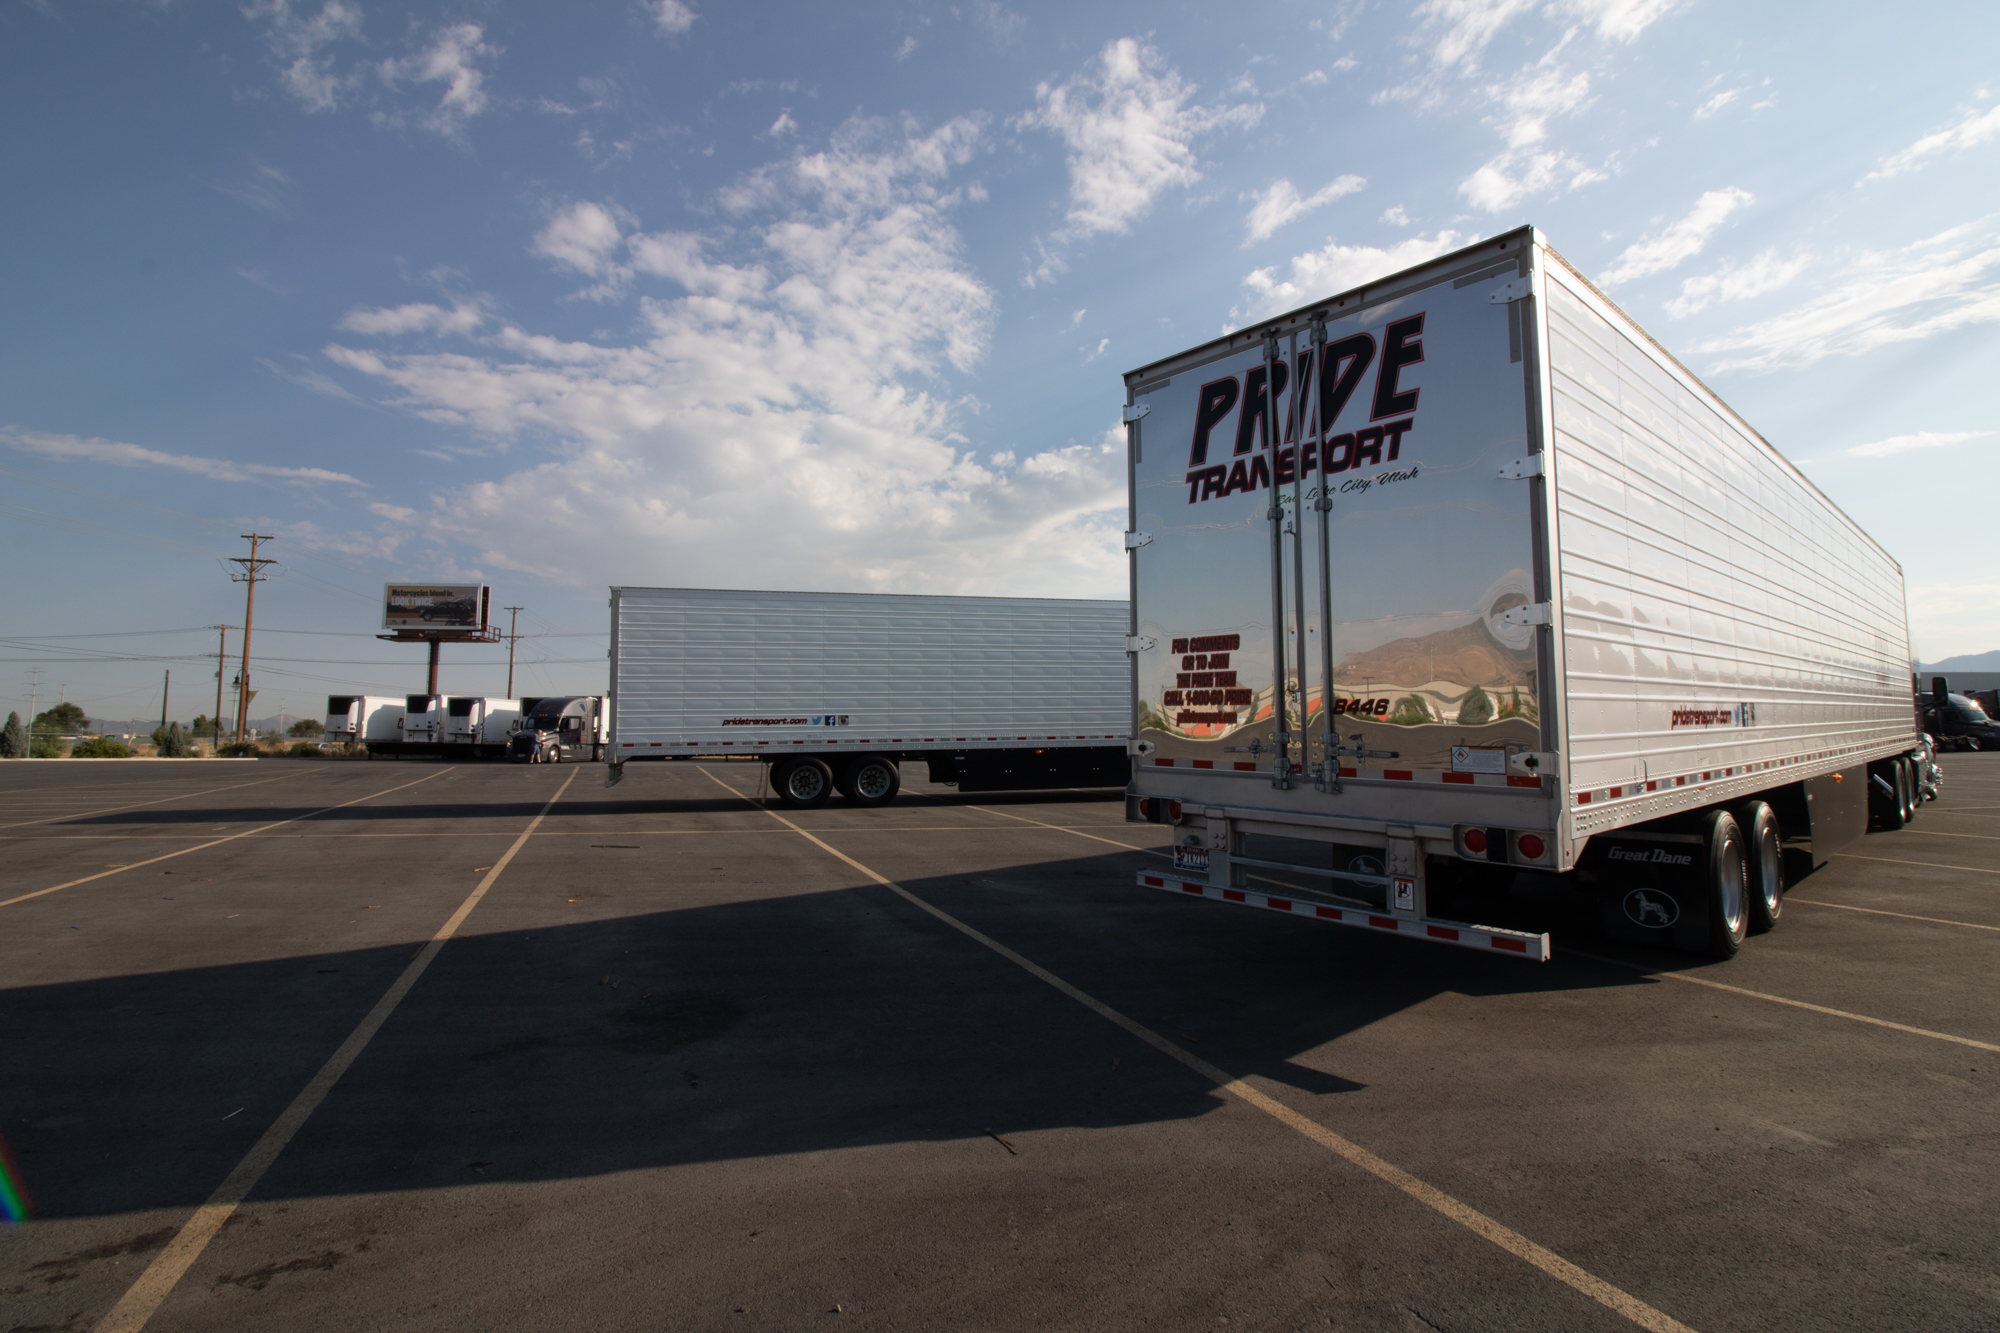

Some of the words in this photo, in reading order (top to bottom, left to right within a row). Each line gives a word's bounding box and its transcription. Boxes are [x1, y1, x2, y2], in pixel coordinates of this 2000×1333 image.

[1189, 311, 1426, 468] PRIDE
[1185, 417, 1414, 504] TRANSPORT
[1340, 479, 1372, 494] City,
[1376, 466, 1419, 485] Utah
[391, 597, 410, 606] LOOK
[392, 589, 429, 598] Motorcycles
[430, 589, 446, 597] blend
[1171, 637, 1189, 655] FOR
[1189, 633, 1240, 653] COMMENTS
[1182, 655, 1195, 671] OR
[1195, 654, 1208, 670] TO
[1208, 652, 1230, 670] JOIN
[1176, 672, 1191, 689] THE
[1191, 671, 1214, 688] PRIDE
[1214, 670, 1237, 687] TEAM
[1163, 690, 1184, 706] CALL
[1185, 689, 1224, 706] 1-800-GO
[1224, 688, 1252, 706] PRIDE
[1332, 698, 1390, 715] 8446
[722, 717, 808, 727] pridetransport.com
[1607, 845, 1650, 862] Great
[1650, 848, 1692, 865] Dane
